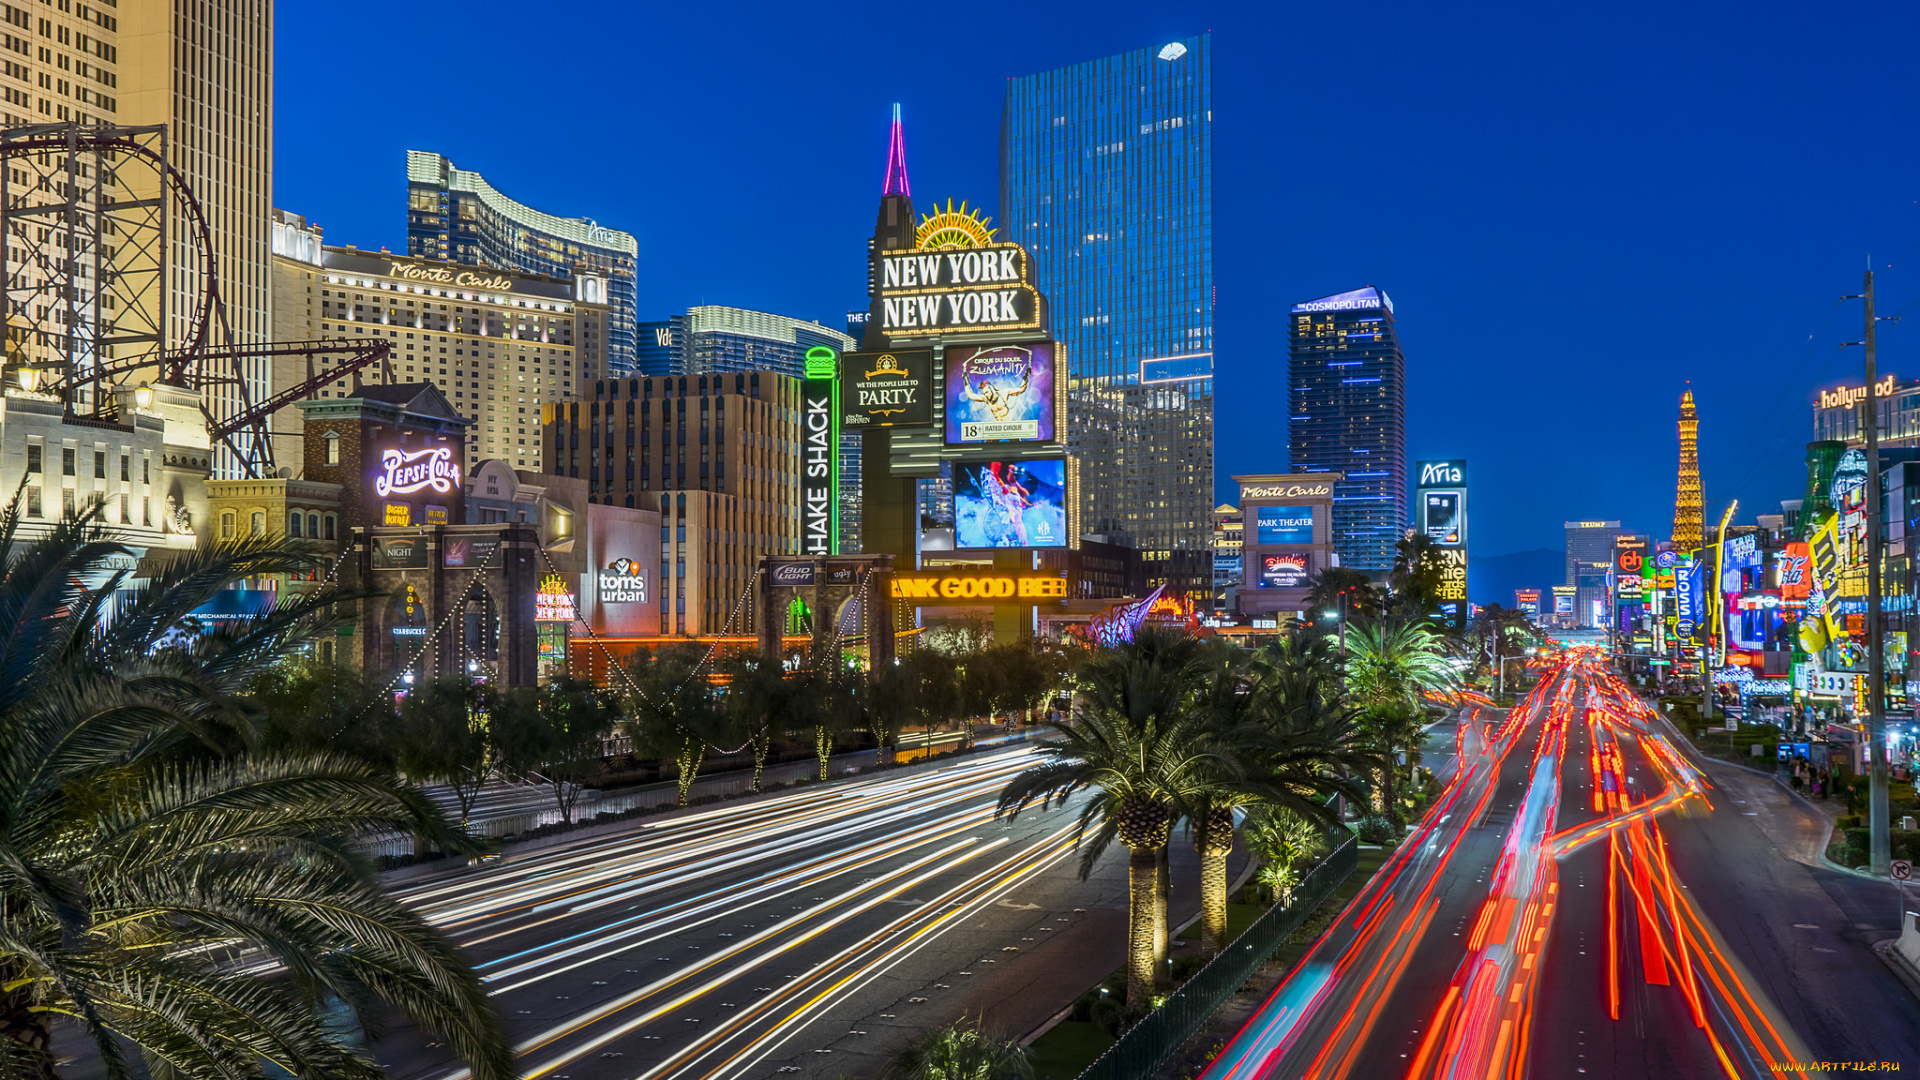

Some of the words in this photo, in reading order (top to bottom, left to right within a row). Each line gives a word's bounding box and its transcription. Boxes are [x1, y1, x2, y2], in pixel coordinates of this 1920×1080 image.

[587, 220, 615, 244] Aria
[389, 262, 454, 283] Monte
[455, 271, 512, 290] Carlo
[883, 256, 942, 288] NEW
[947, 250, 1019, 284] YORK
[883, 295, 942, 328] NEW
[947, 291, 1019, 325] YORK
[1305, 299, 1379, 312] COSMOPOLITAN
[847, 314, 863, 323] THE
[970, 362, 1027, 378] ZUMANITY
[897, 379, 909, 387] LIKE
[858, 388, 917, 406] PARTY.
[1821, 375, 1893, 409] hollywod
[807, 397, 828, 478] SHACK
[1421, 463, 1462, 485] Aria
[1242, 486, 1286, 498] Monte
[1286, 485, 1329, 497] Carlo
[386, 504, 409, 515] BIGGER
[807, 487, 828, 556] HAKE
[1257, 519, 1278, 527] PARK
[1279, 518, 1313, 526] THEATER
[387, 548, 413, 556] NIGHT
[600, 573, 644, 590] toms
[834, 568, 851, 579] ugly
[601, 588, 645, 602] urban
[939, 578, 1015, 598] GOOD
[1017, 578, 1067, 597] BEER
[1678, 569, 1690, 616] ROSS
[536, 593, 554, 606] NEW
[536, 606, 554, 619] NEW
[555, 606, 575, 619] YORK
